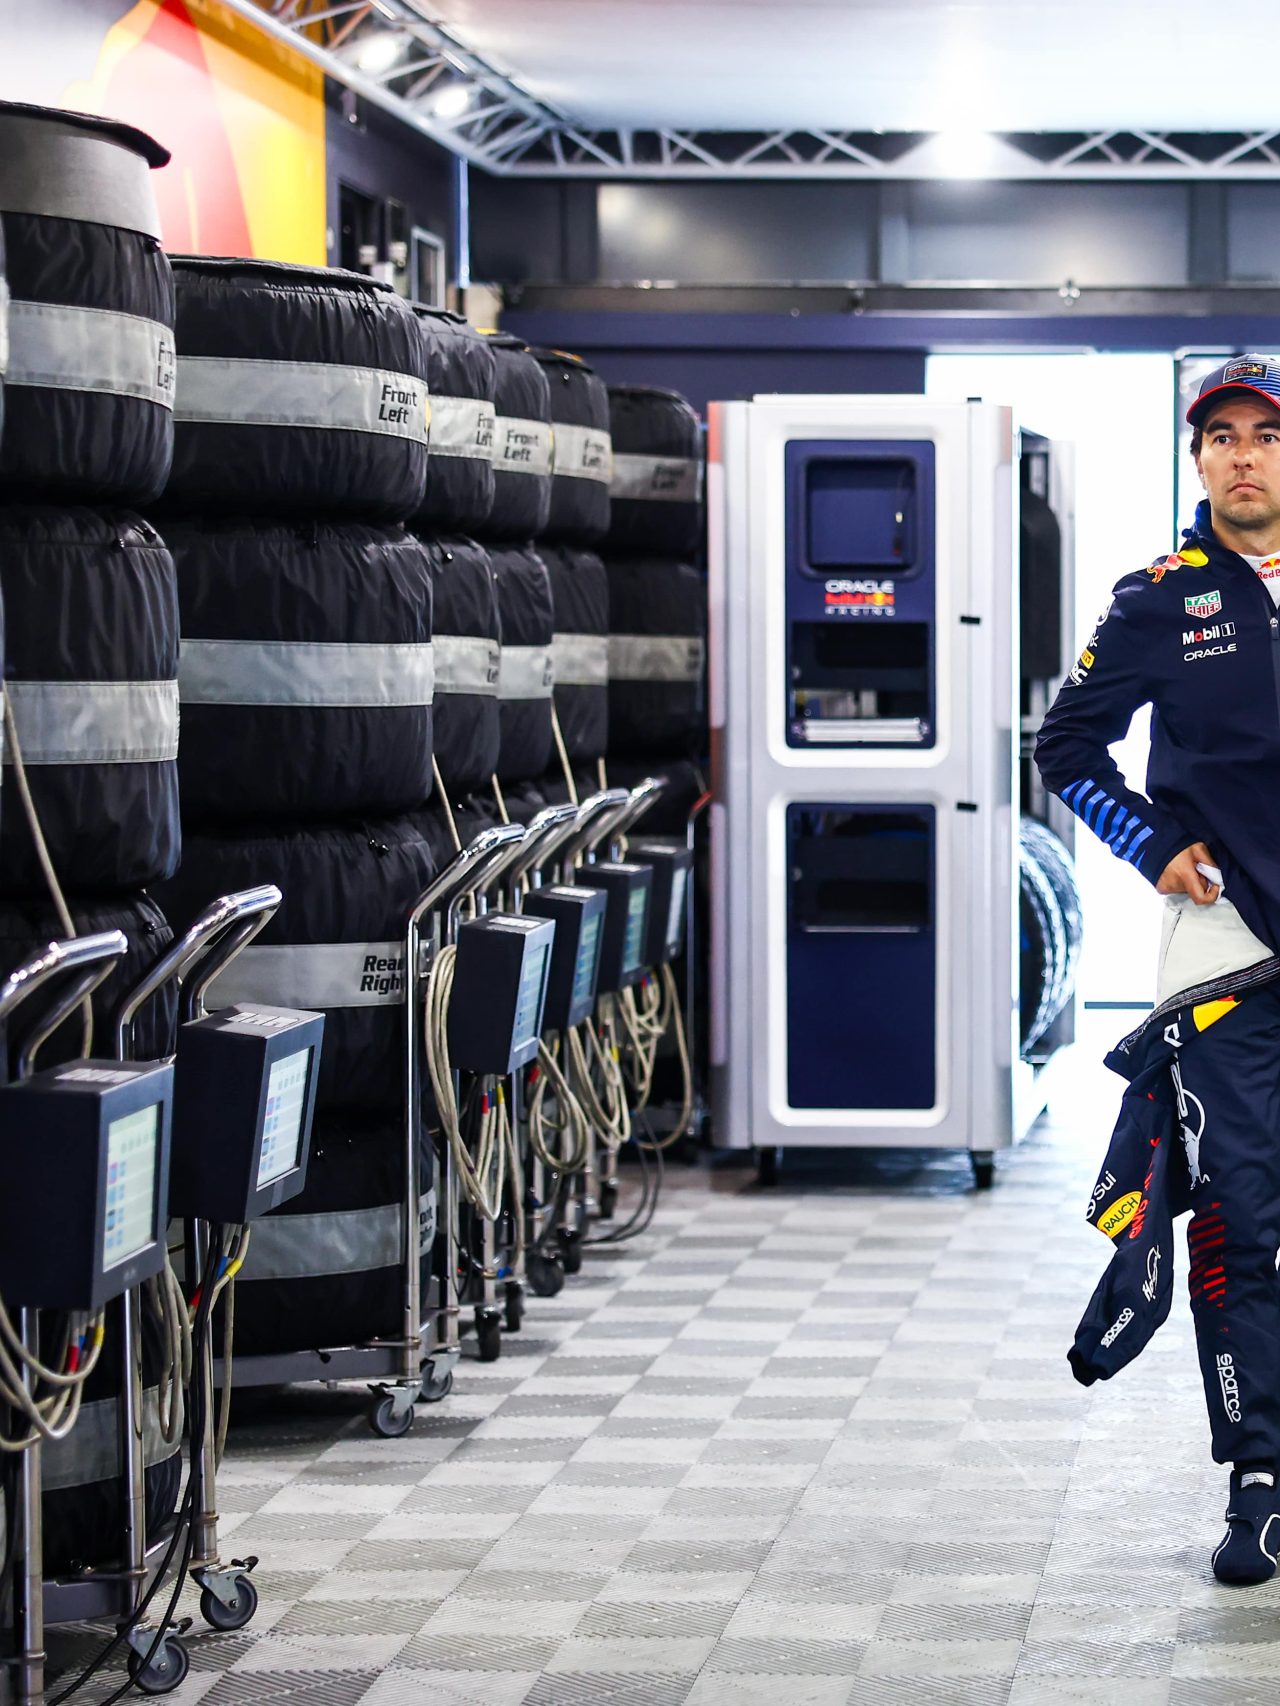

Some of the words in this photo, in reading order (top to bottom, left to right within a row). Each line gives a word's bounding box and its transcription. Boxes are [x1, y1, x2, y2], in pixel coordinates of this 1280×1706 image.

[1228, 363, 1263, 372] ORACLE
[381, 384, 418, 408] Front
[379, 403, 409, 425] Left
[506, 429, 539, 448] Front
[503, 446, 531, 463] Left
[824, 580, 895, 594] ORACLE
[1186, 602, 1221, 615] HEUER
[1187, 592, 1219, 606] TAG
[1182, 625, 1221, 646] Mobil
[1183, 643, 1238, 662] ORACLE
[1093, 1170, 1117, 1201] Sui
[1103, 1196, 1139, 1232] RAUCH
[1100, 1307, 1135, 1348] sparco
[1215, 1353, 1242, 1424] sparco
